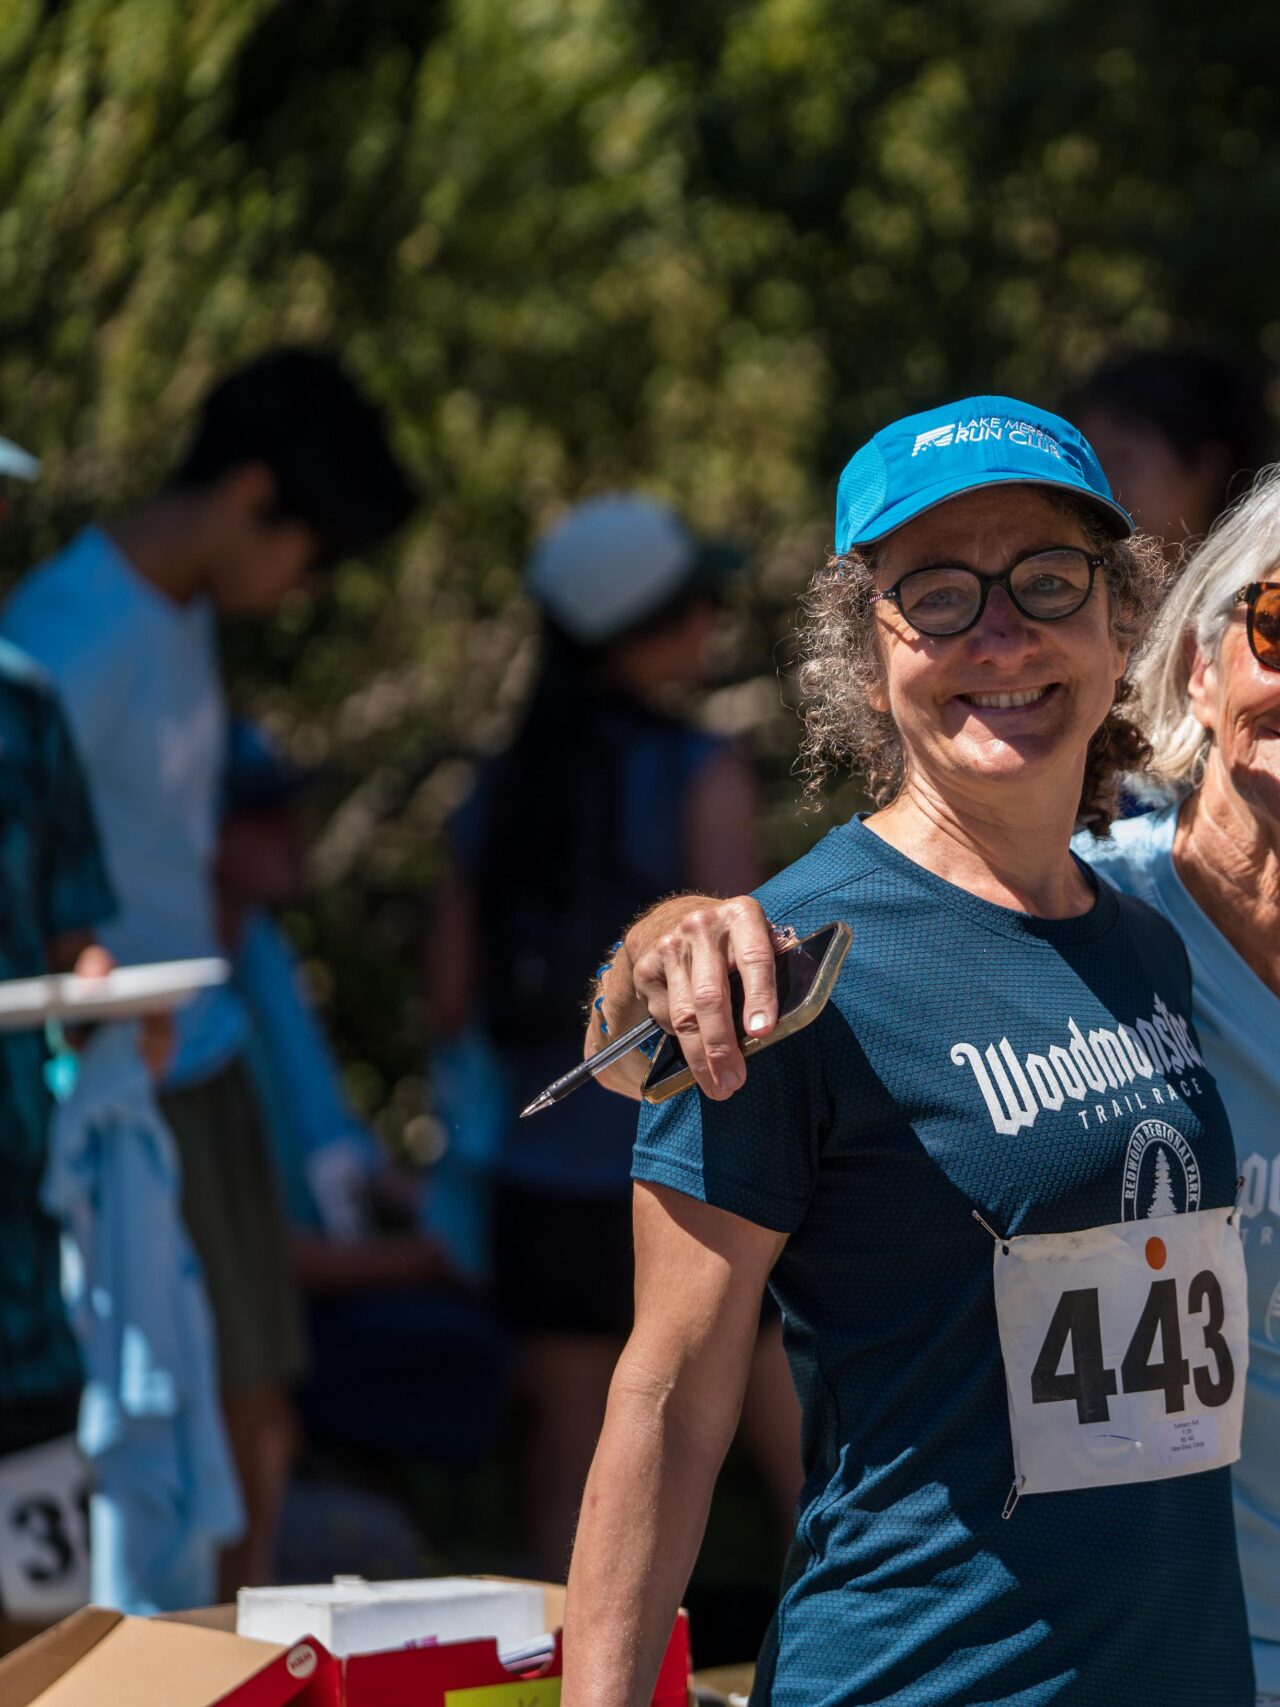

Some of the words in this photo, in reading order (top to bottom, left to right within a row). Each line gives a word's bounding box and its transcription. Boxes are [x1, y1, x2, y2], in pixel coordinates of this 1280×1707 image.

[955, 428, 1003, 444] RUN
[1008, 430, 1062, 460] CLUB
[958, 417, 1001, 430] LAKE
[1078, 1092, 1147, 1130] TRAIL
[1151, 1077, 1203, 1105] RACE
[1124, 1132, 1146, 1200] REDWOOD
[1142, 1123, 1192, 1164] REGIONAL
[1186, 1164, 1199, 1202] PARK
[1030, 1268, 1235, 1426] 443
[8, 1480, 91, 1587] 3
